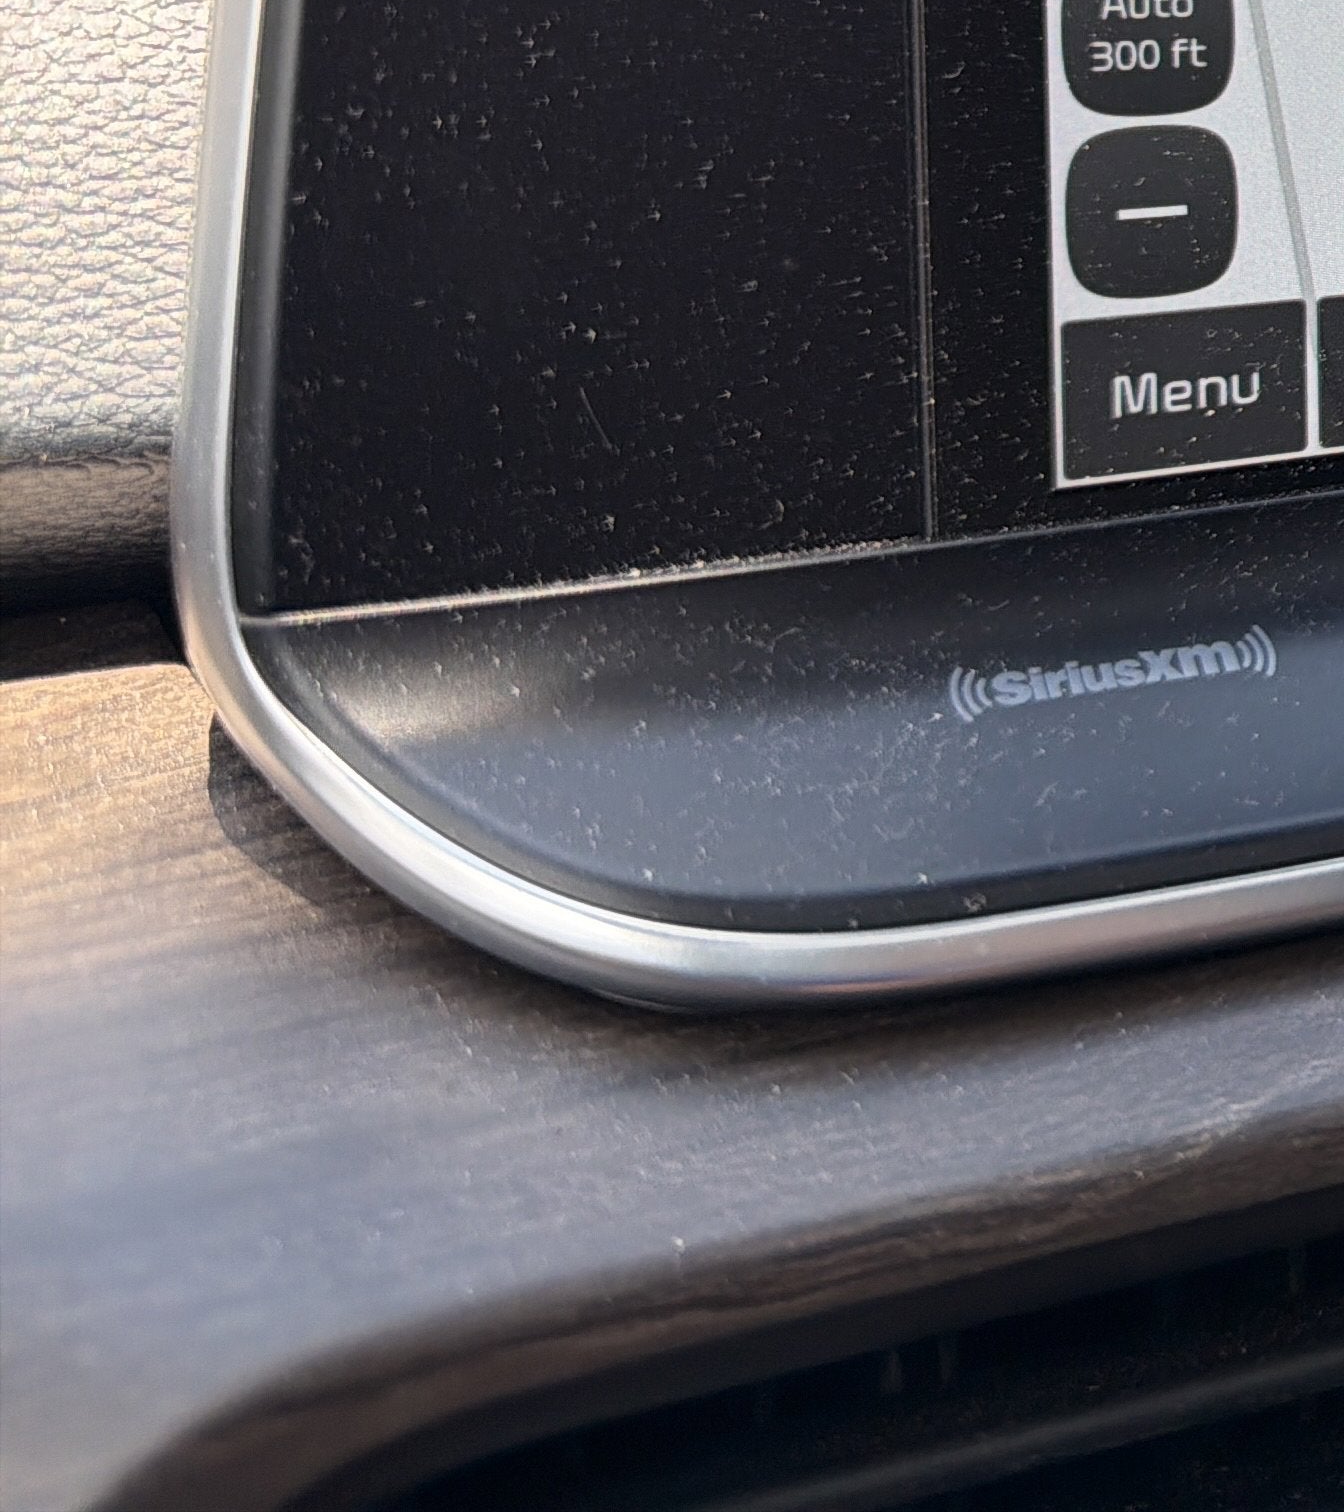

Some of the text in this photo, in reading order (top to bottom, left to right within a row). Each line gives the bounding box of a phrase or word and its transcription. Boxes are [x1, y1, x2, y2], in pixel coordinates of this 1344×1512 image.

[1089, 36, 1208, 73] 300 ft
[1109, 367, 1260, 420] Menu
